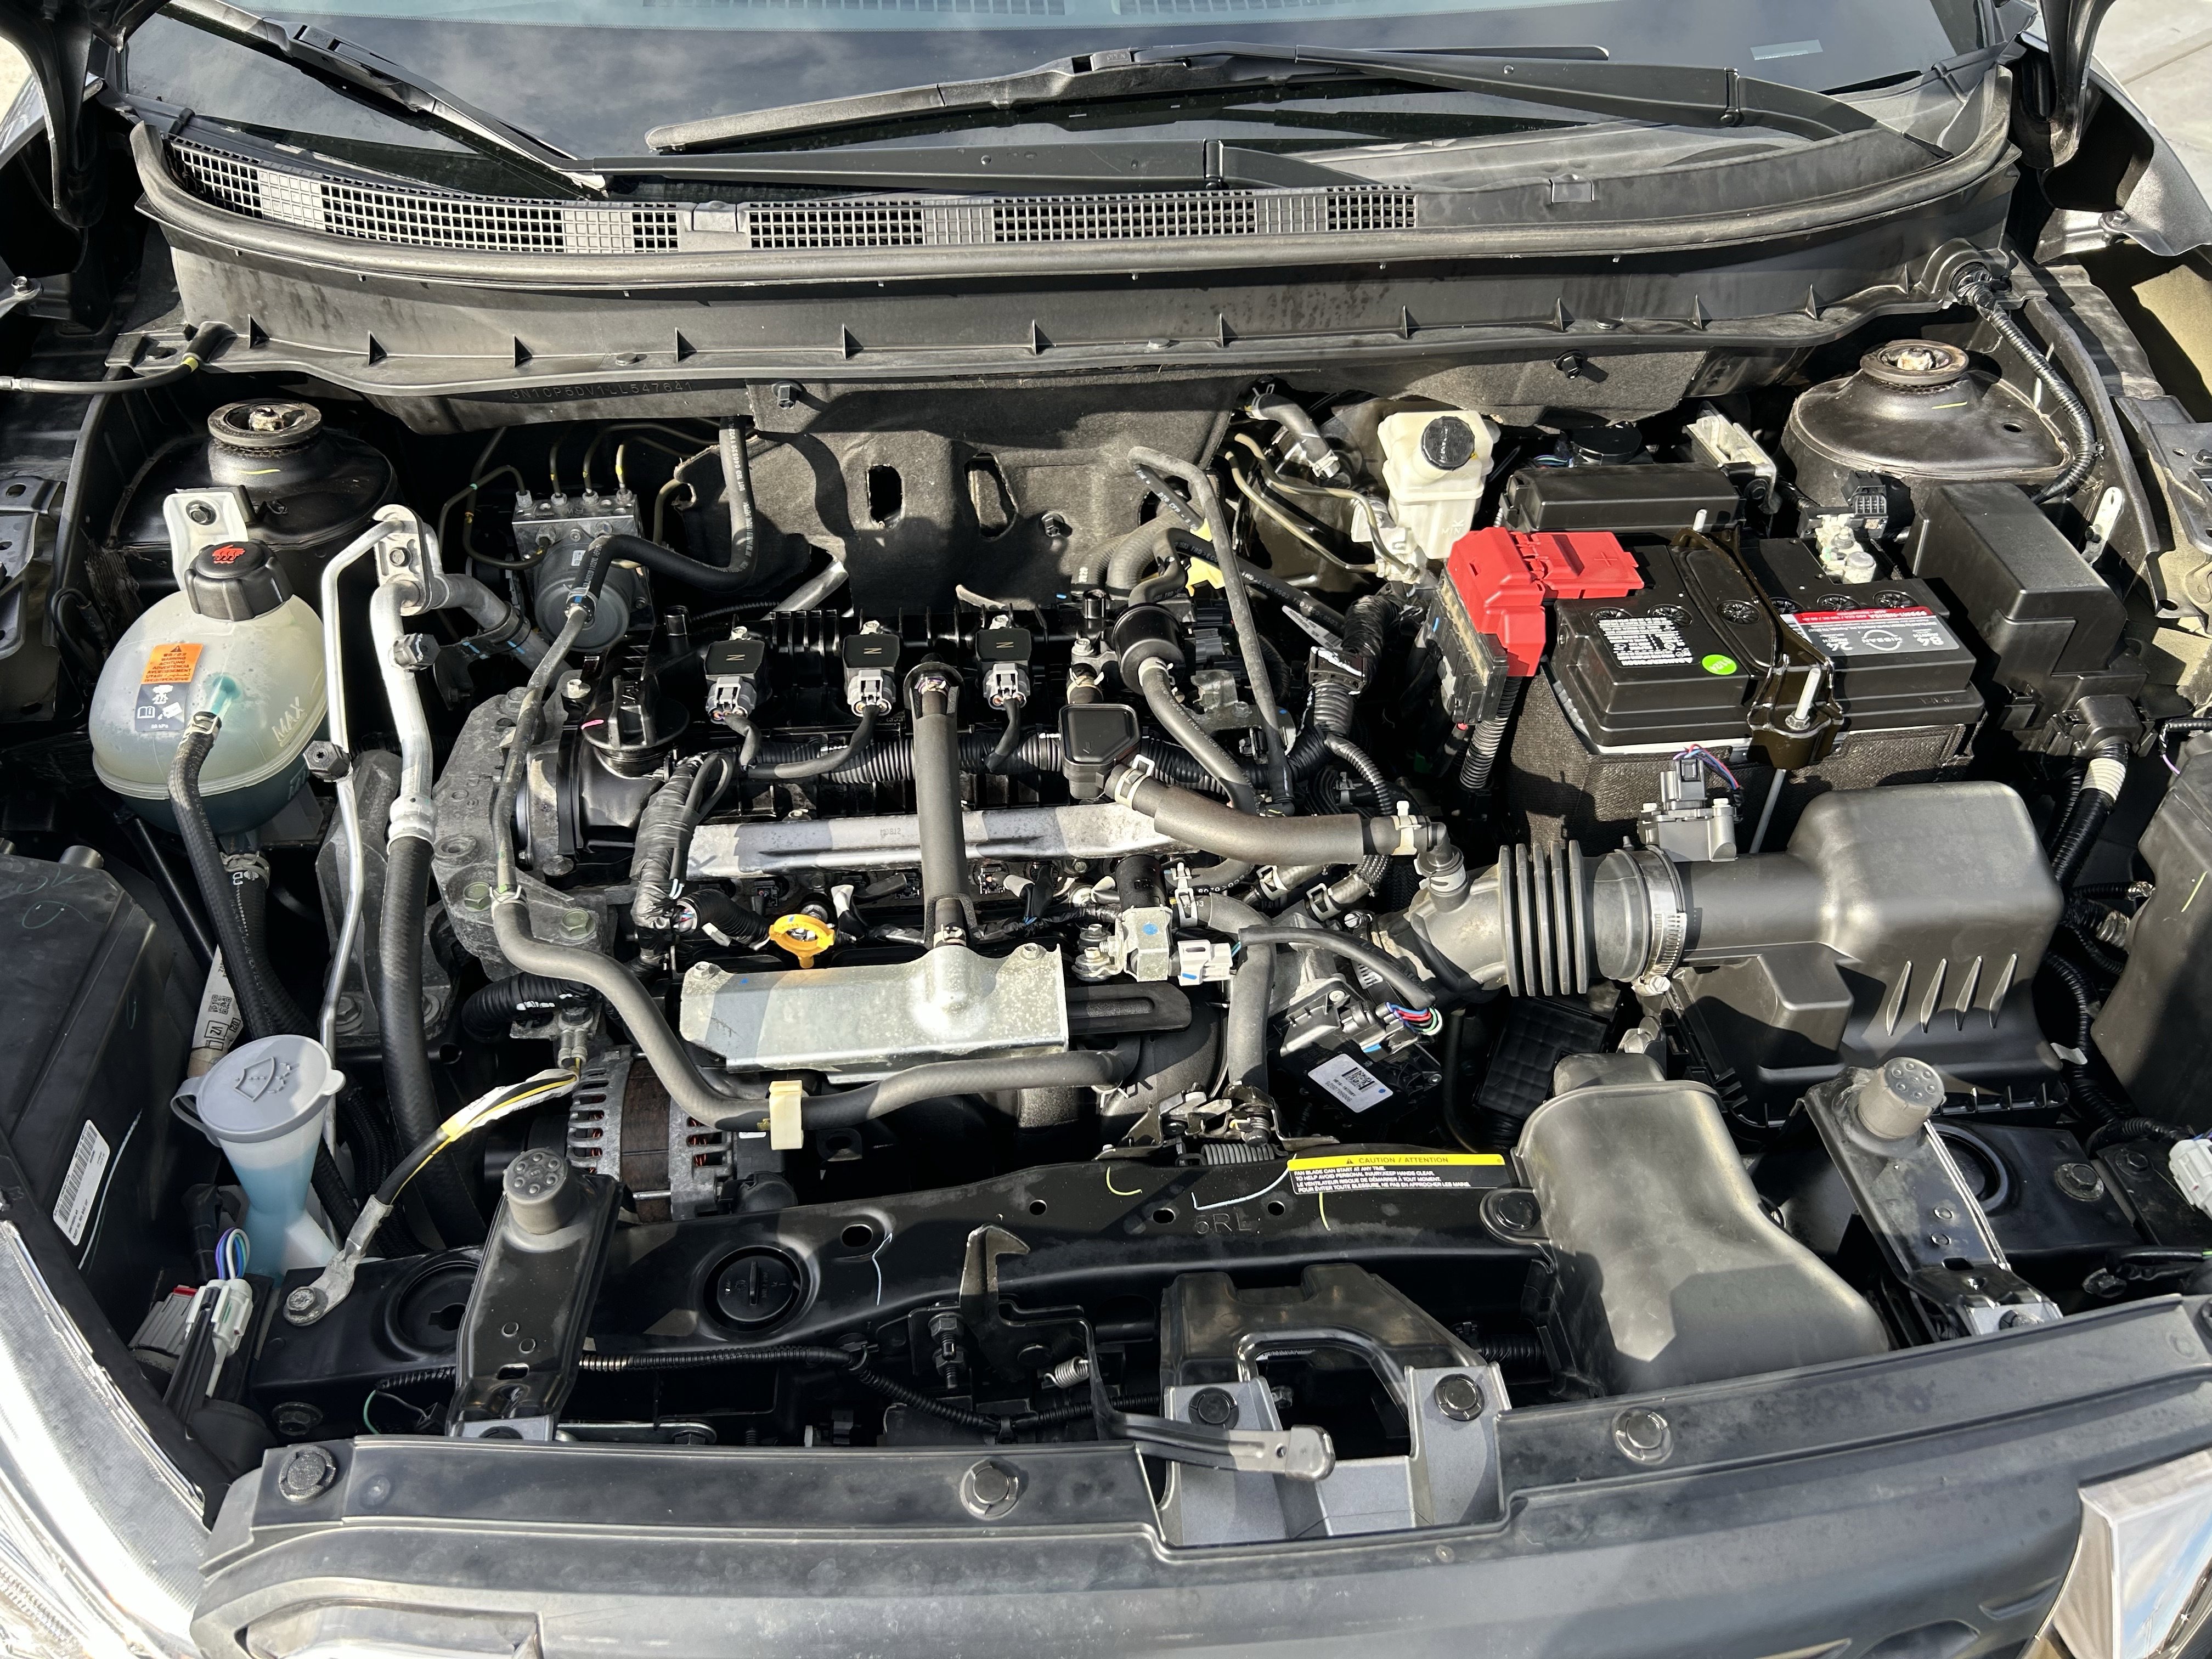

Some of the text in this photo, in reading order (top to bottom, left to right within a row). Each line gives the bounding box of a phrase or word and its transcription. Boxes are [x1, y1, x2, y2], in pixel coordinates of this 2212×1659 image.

[510, 381, 692, 399] 3N1CP5DV1LL547641
[1824, 641, 1853, 651] 24
[1916, 636, 1944, 646] 84
[272, 697, 305, 743] MAX
[210, 1026, 222, 1036] VZ
[1194, 1211, 1251, 1234] 5RL
